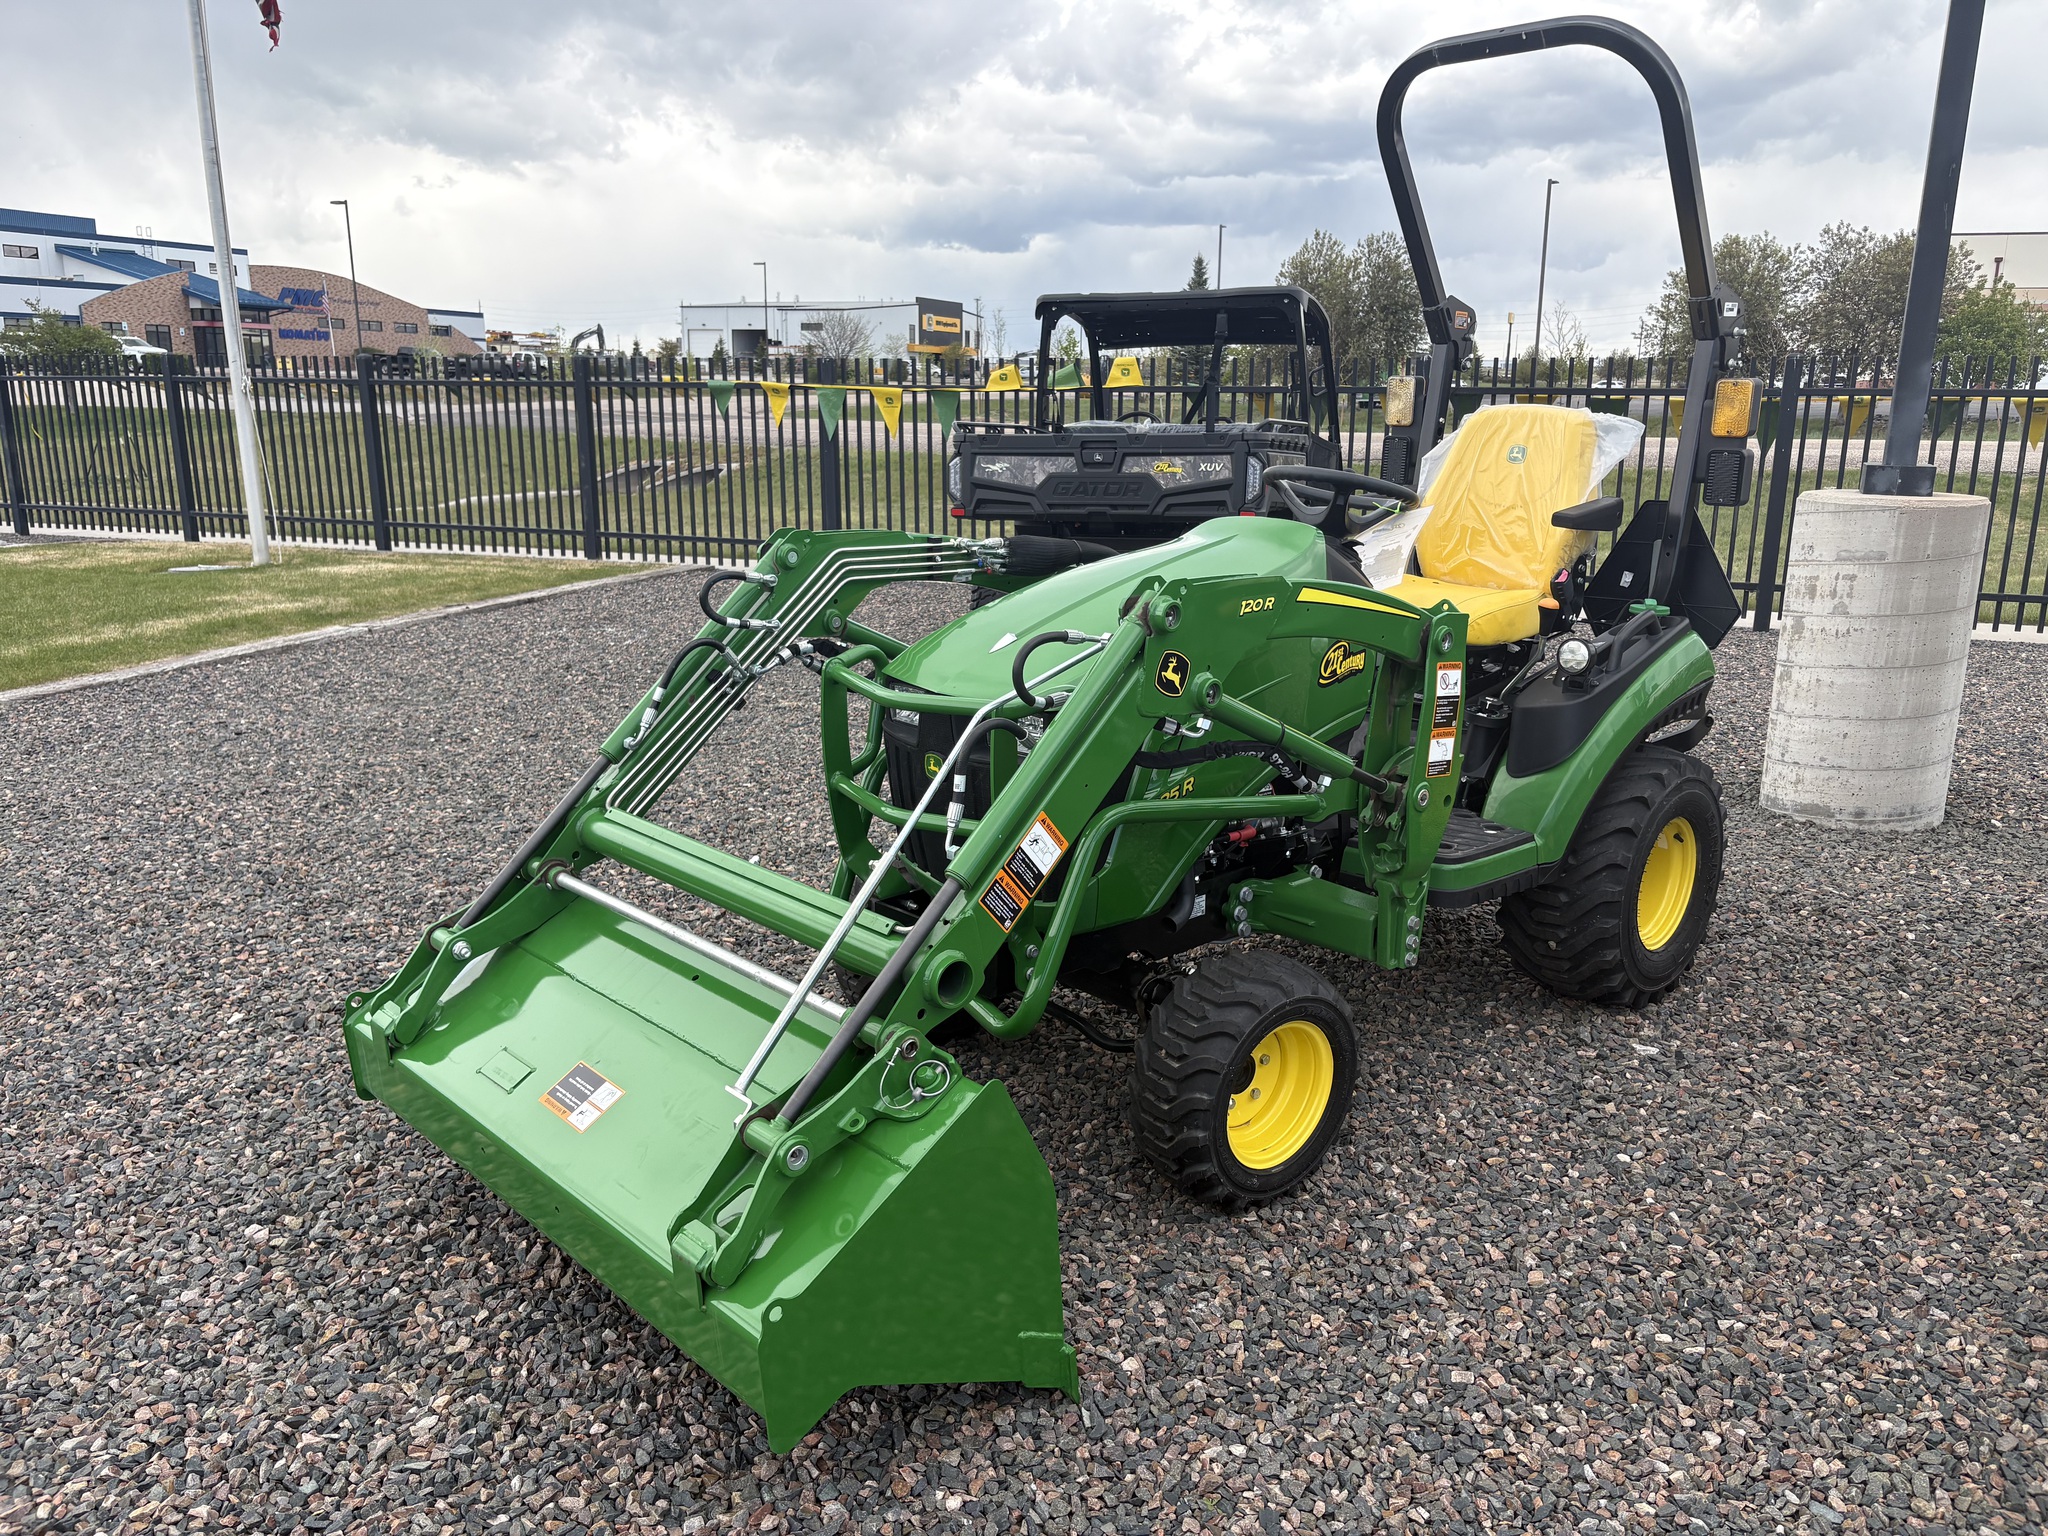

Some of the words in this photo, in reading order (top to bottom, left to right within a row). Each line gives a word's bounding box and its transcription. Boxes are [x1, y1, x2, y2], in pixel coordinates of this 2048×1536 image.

[278, 287, 328, 307] PMC
[1198, 462, 1224, 471] XUV
[1052, 481, 1145, 498] GATOR
[1239, 599, 1263, 616] 120
[1264, 597, 1275, 610] R
[1442, 662, 1461, 670] WARNING
[1436, 730, 1454, 738] WARNING
[1045, 823, 1064, 847] WARNING
[1004, 882, 1024, 905] WARNING
